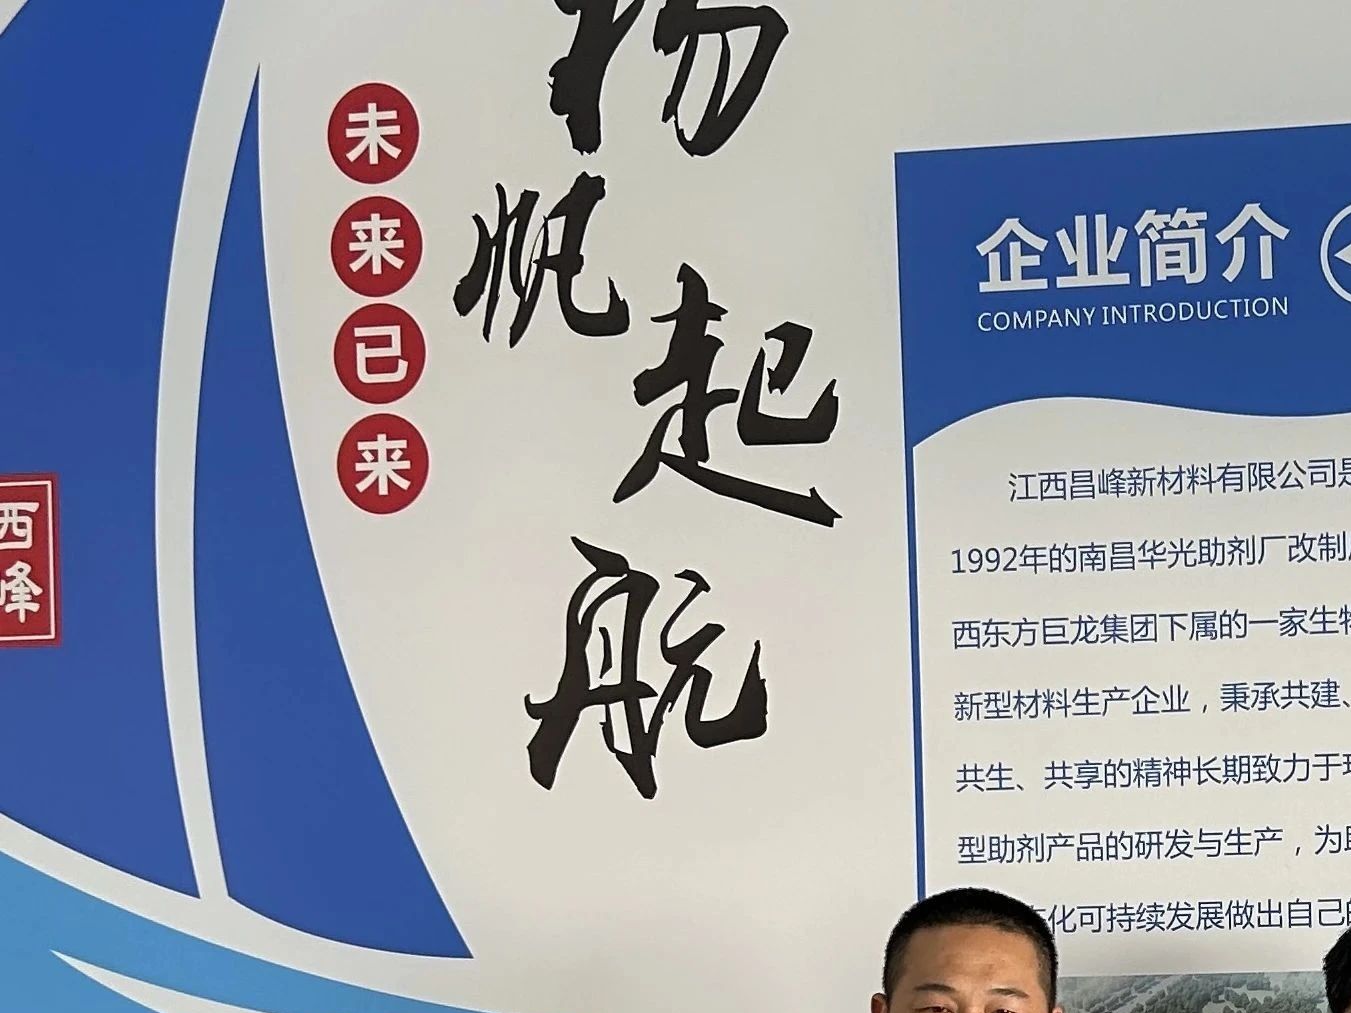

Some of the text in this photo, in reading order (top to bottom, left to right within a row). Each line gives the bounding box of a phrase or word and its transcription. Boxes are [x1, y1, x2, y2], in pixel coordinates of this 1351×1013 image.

[976, 202, 1290, 293] 企业简介
[344, 103, 411, 496] 未来已来
[977, 296, 1289, 332] COMPANY INTRODUCTION
